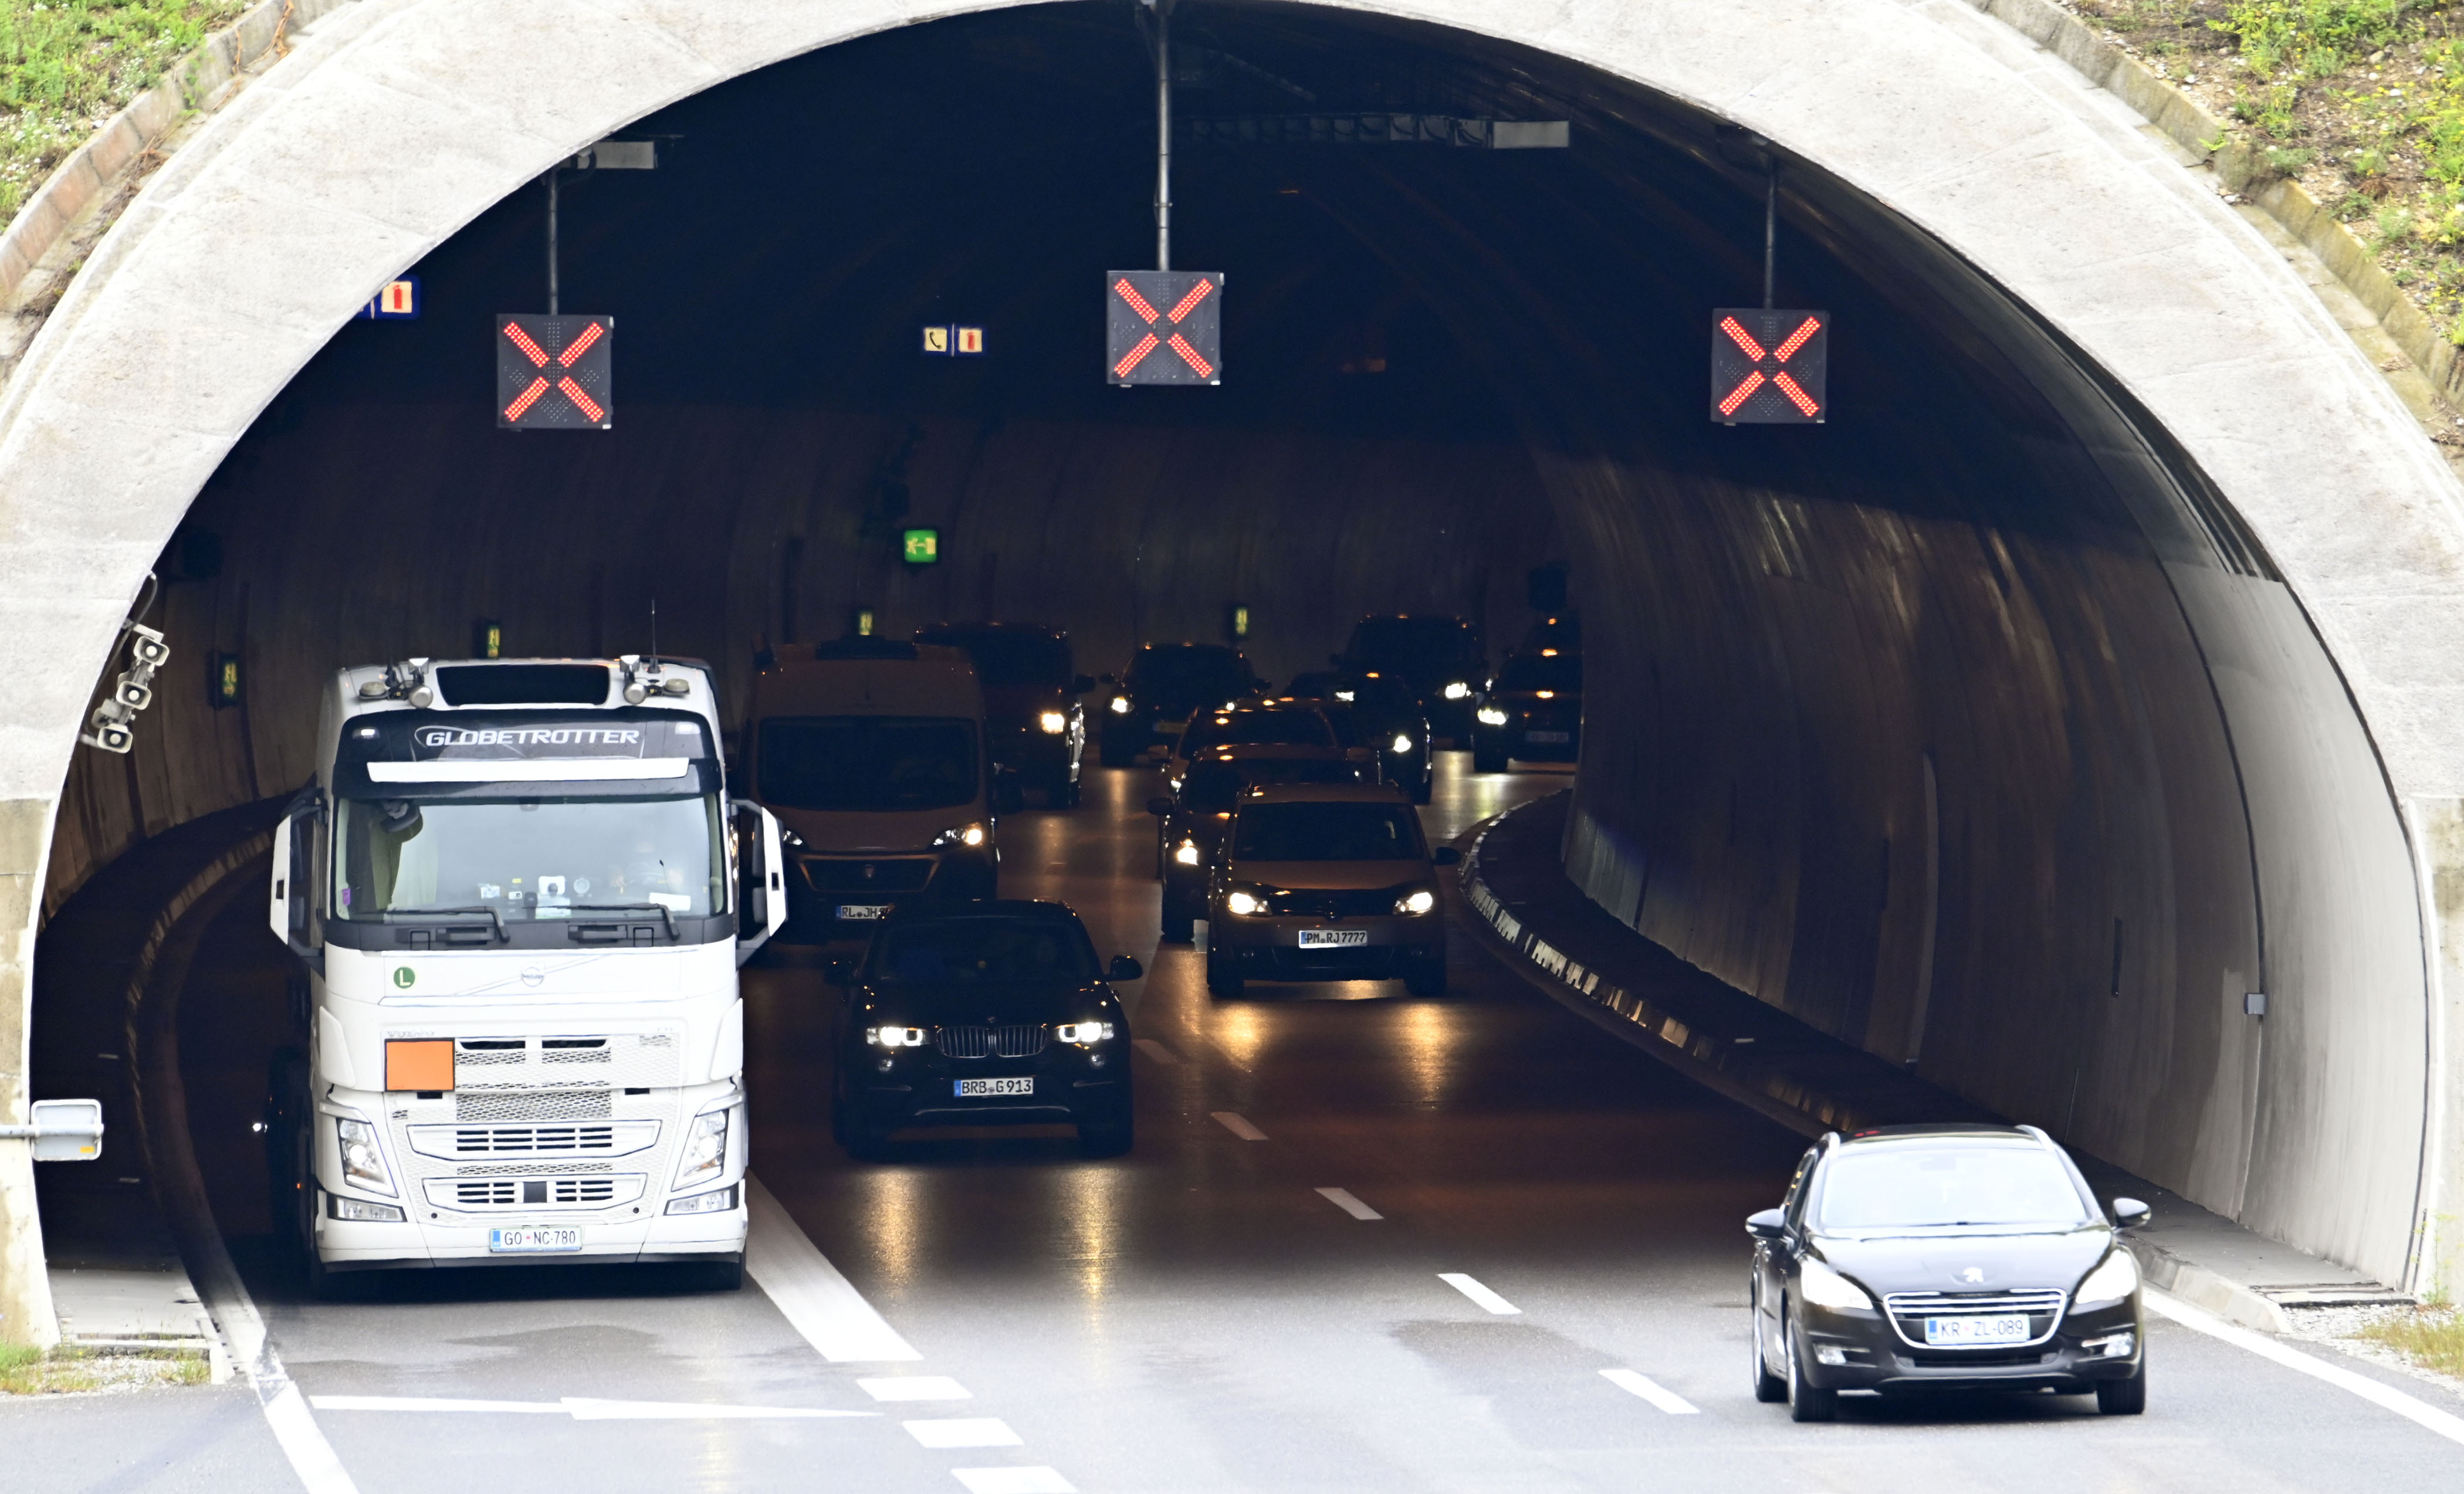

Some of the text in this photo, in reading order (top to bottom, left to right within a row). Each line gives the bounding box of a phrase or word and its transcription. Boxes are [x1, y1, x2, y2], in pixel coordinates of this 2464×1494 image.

[425, 729, 639, 746] GLOBETROTTER
[842, 907, 855, 917] RL
[864, 907, 877, 917] JH
[1307, 932, 1366, 944] PM RJ 7777
[400, 970, 411, 986] L
[962, 1080, 1031, 1094] BRB G 913
[505, 1232, 522, 1245] GO
[1941, 1320, 2023, 1337] KR ZL-089
